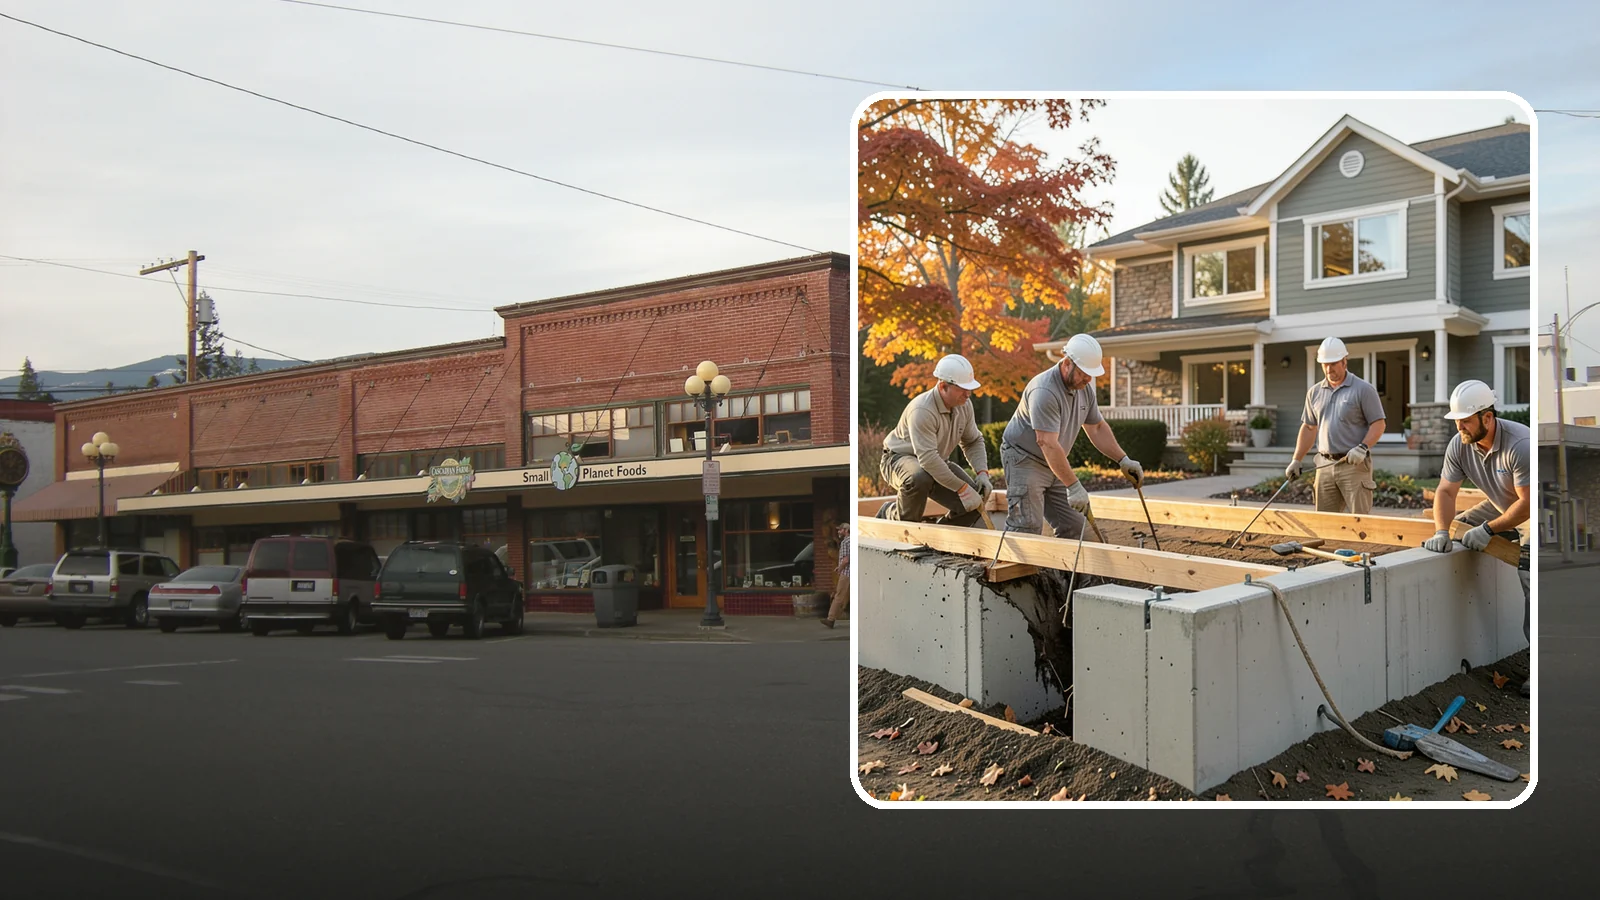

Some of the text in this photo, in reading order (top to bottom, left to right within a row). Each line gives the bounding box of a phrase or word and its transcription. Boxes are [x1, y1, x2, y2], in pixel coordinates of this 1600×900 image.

[523, 464, 647, 483] Small Planet Foods
